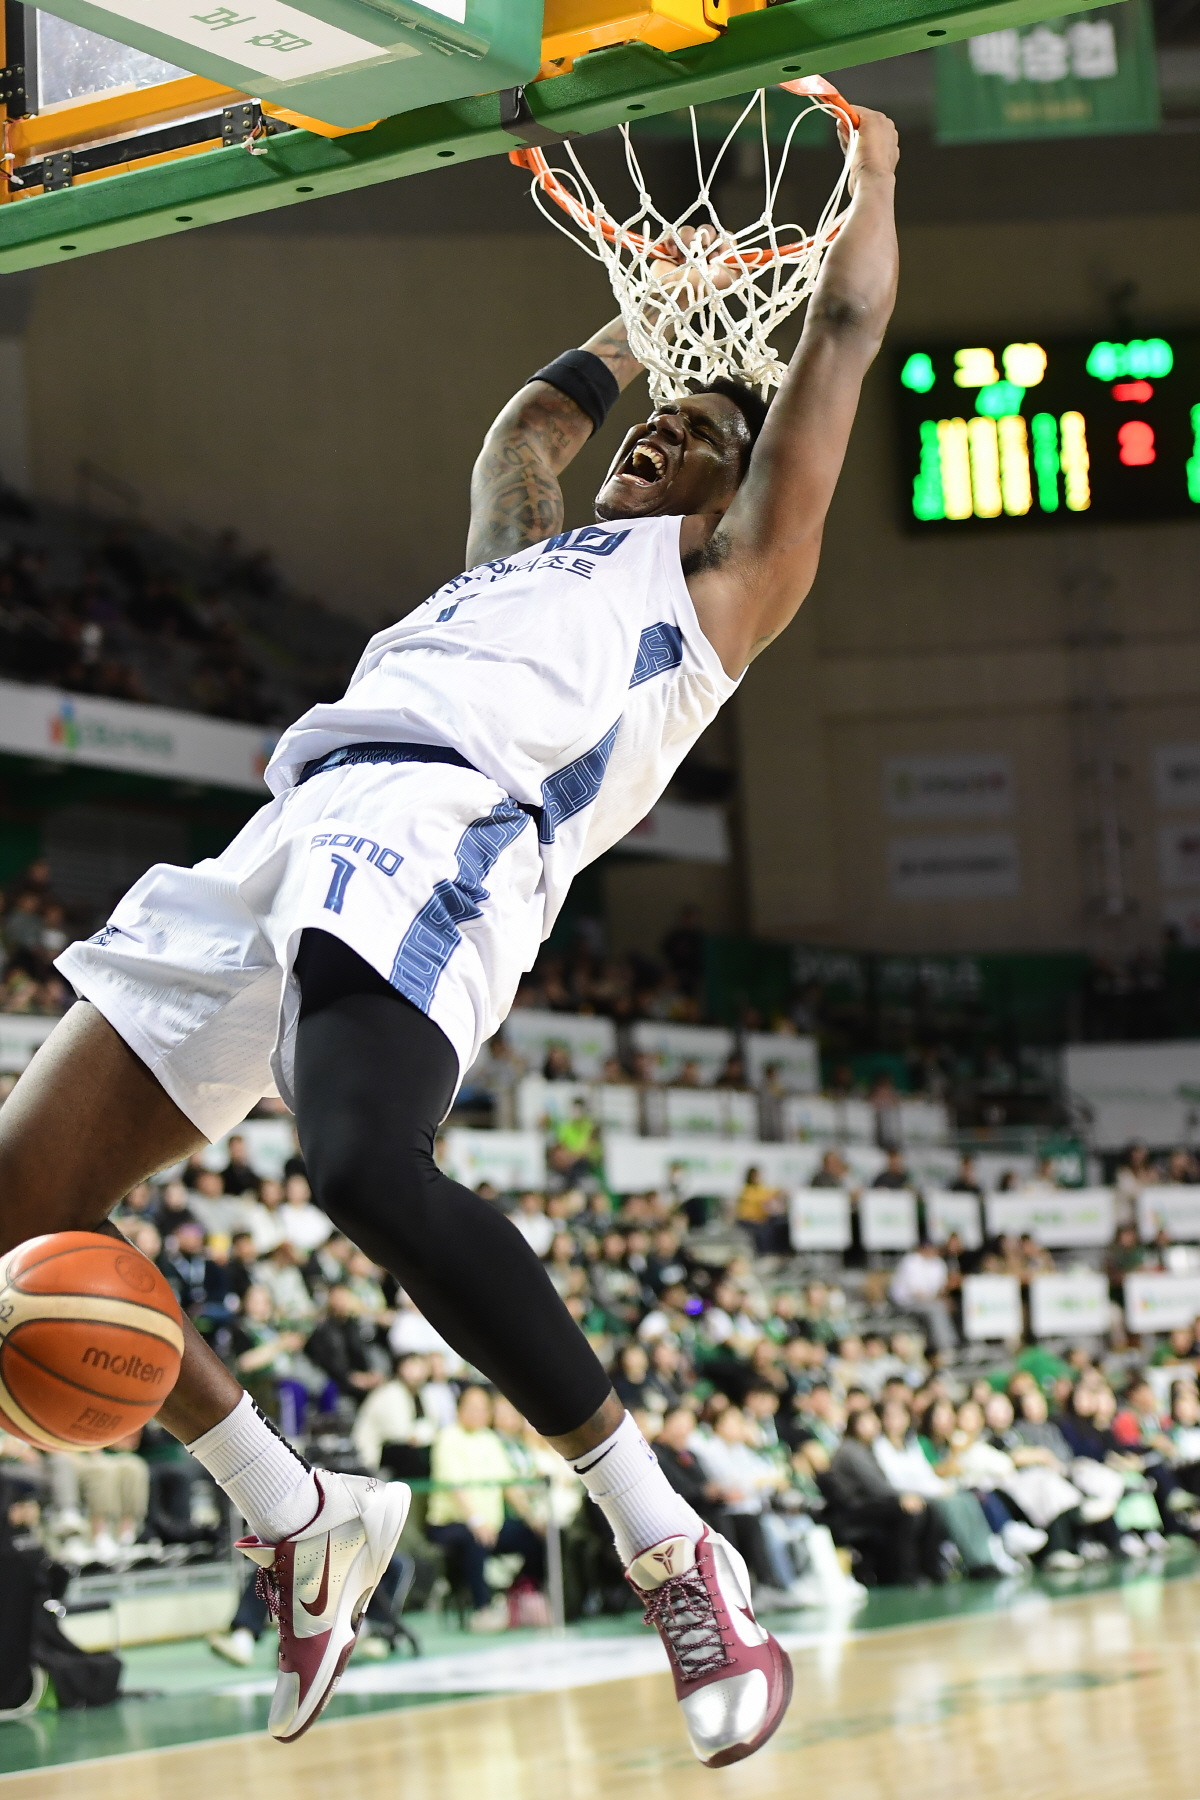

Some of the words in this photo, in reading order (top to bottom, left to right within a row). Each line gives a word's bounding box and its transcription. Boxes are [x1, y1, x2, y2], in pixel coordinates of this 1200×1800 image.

[309, 833, 405, 877] SONO
[323, 852, 357, 916] 1
[82, 1347, 164, 1384] molten
